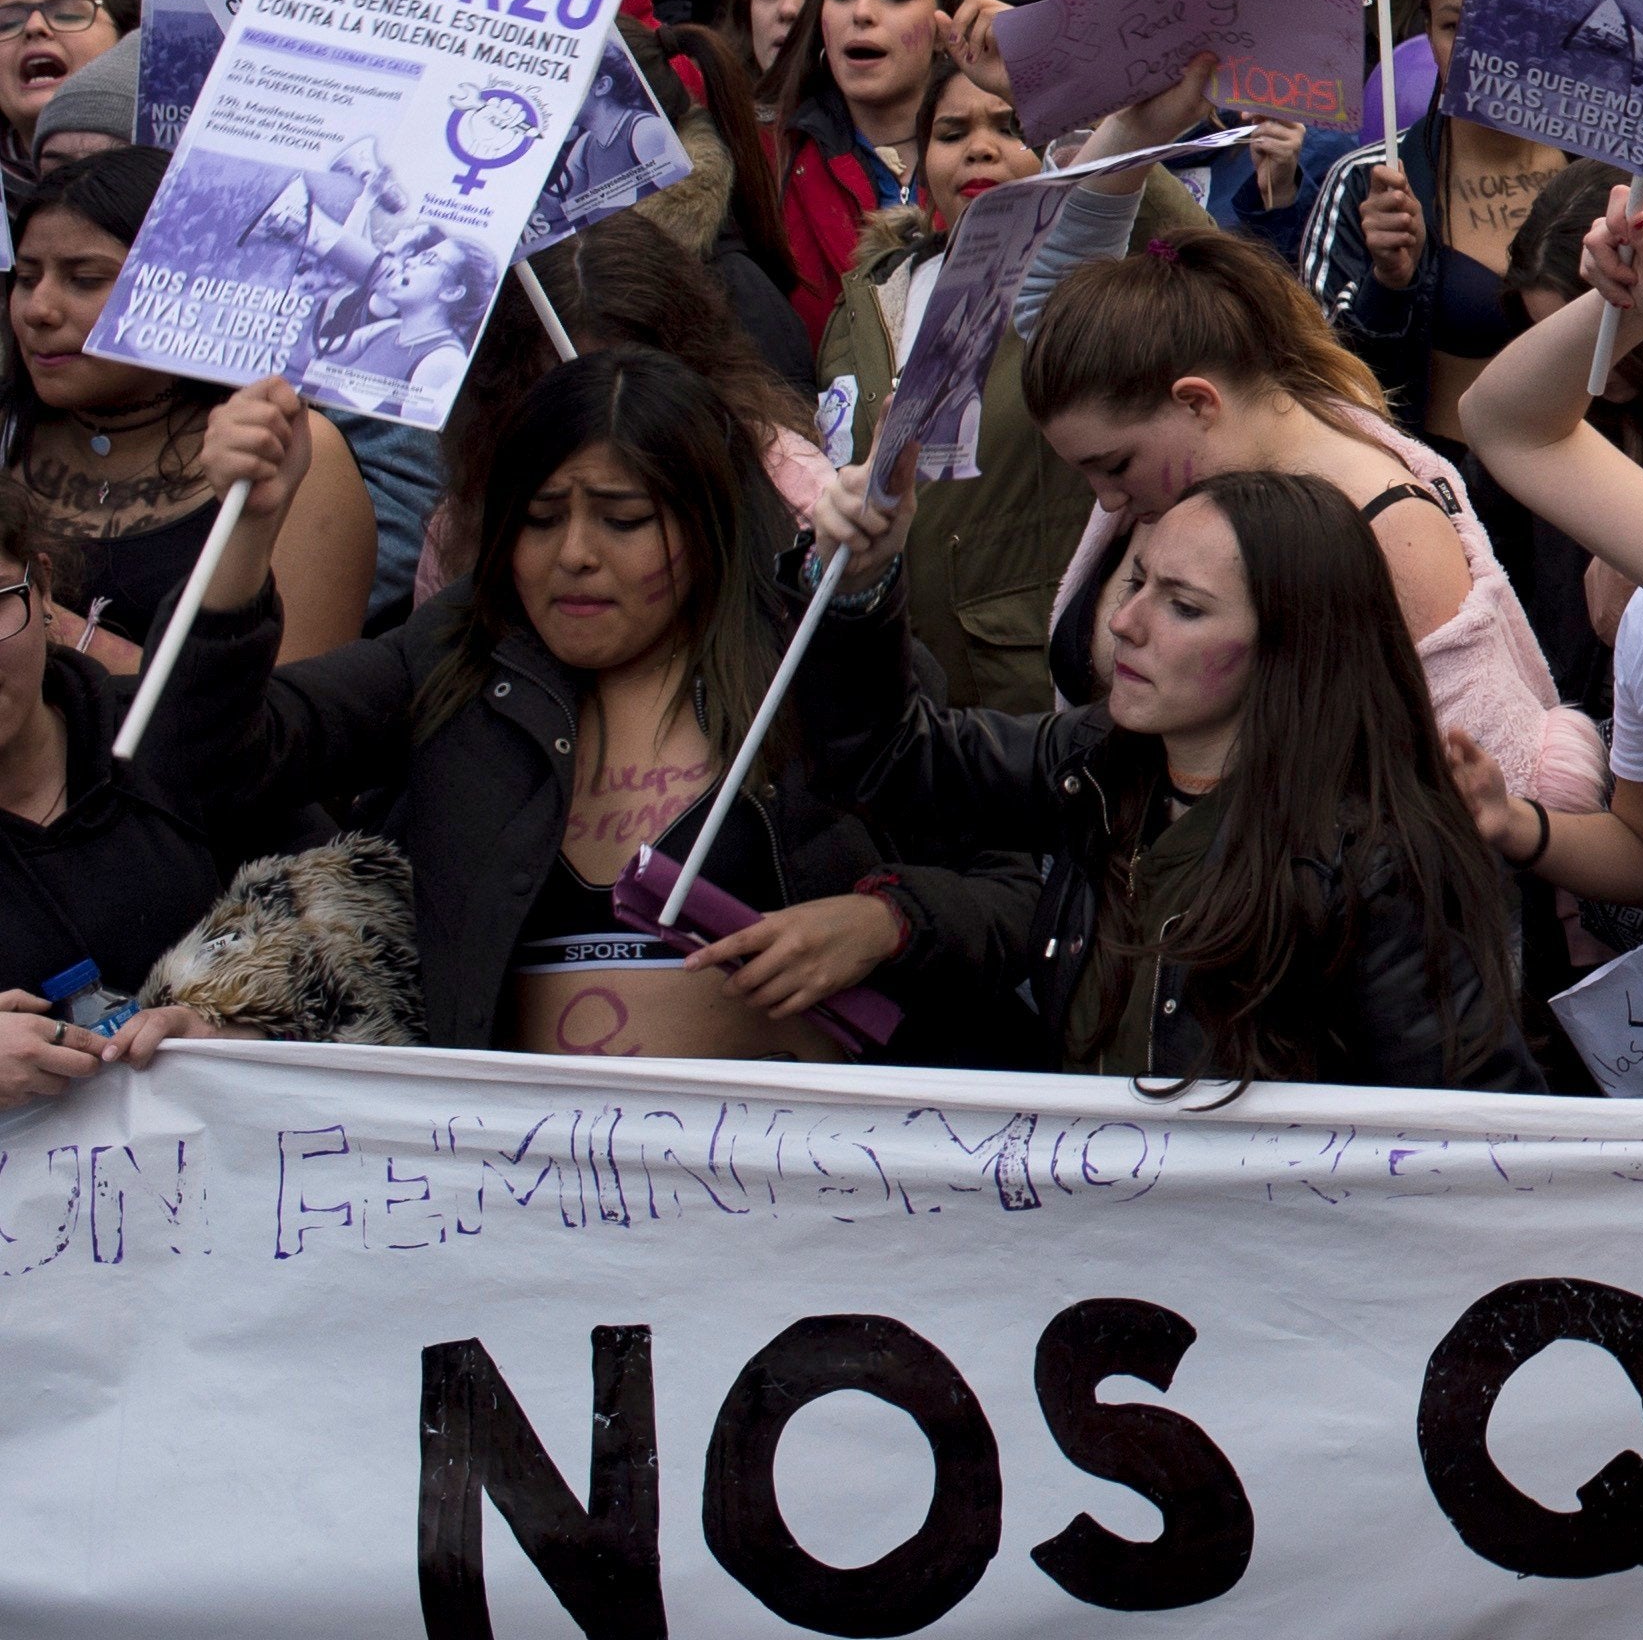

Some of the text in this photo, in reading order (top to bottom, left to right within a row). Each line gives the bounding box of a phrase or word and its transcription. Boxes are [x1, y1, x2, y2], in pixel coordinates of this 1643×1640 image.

[1118, 1, 1188, 49] Real
[1217, 56, 1337, 110] TODAS
[564, 943, 647, 961] SPORT
[419, 1297, 1255, 1639] NOS
